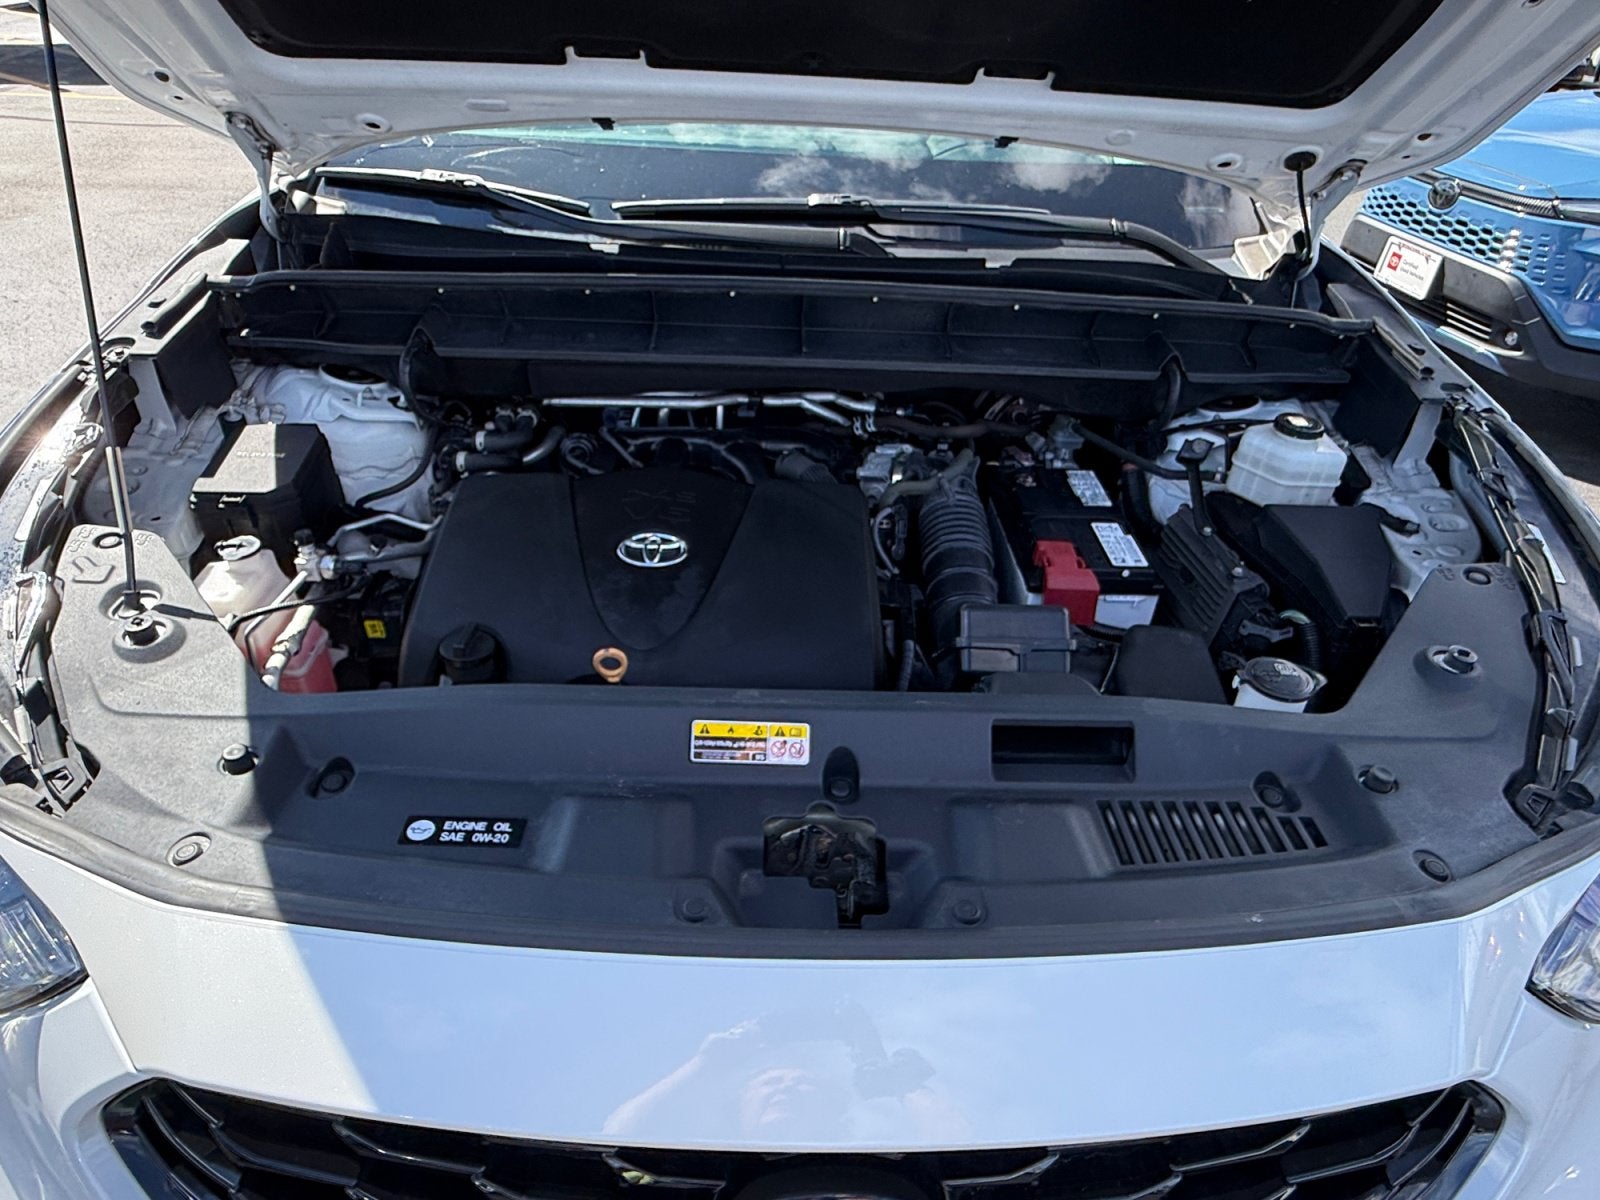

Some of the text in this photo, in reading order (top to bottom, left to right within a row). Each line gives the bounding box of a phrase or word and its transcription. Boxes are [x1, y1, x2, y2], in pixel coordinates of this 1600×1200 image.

[443, 820, 513, 832] ENGINE OIL
[439, 831, 510, 844] SAE 0W-20
